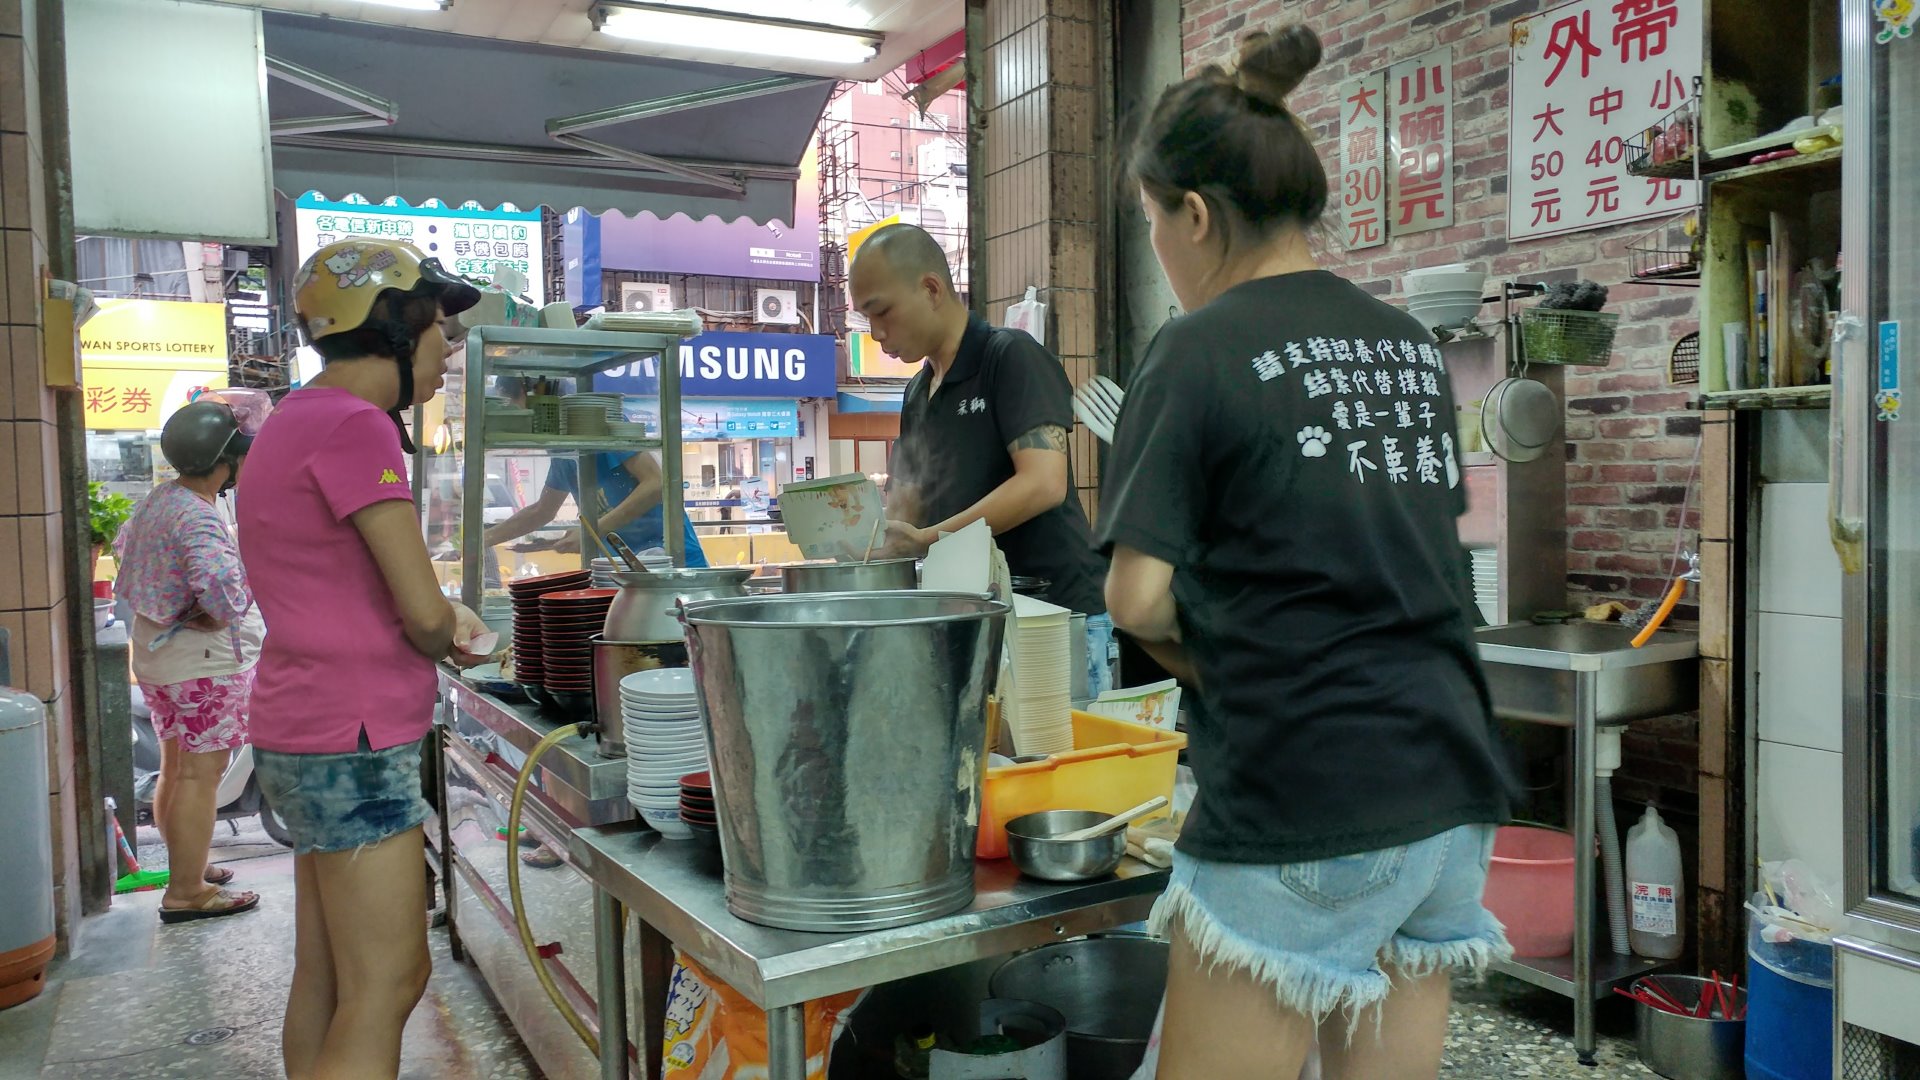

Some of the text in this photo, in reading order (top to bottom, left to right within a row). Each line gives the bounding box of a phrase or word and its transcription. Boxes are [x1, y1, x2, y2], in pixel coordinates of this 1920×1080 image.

[1543, 0, 1678, 88] 外帶
[1398, 65, 1445, 226] 小碗20元
[1344, 86, 1382, 247] 大碗30元
[454, 240, 529, 258] 手機包膜
[116, 341, 162, 352] SPORTS
[166, 343, 215, 353] LOTTERY
[1303, 366, 1441, 399] 結紮代替撲殺
[86, 386, 152, 413] 彩券
[1331, 400, 1436, 430] 愛是一輩子
[1346, 434, 1443, 484] 不棄養
